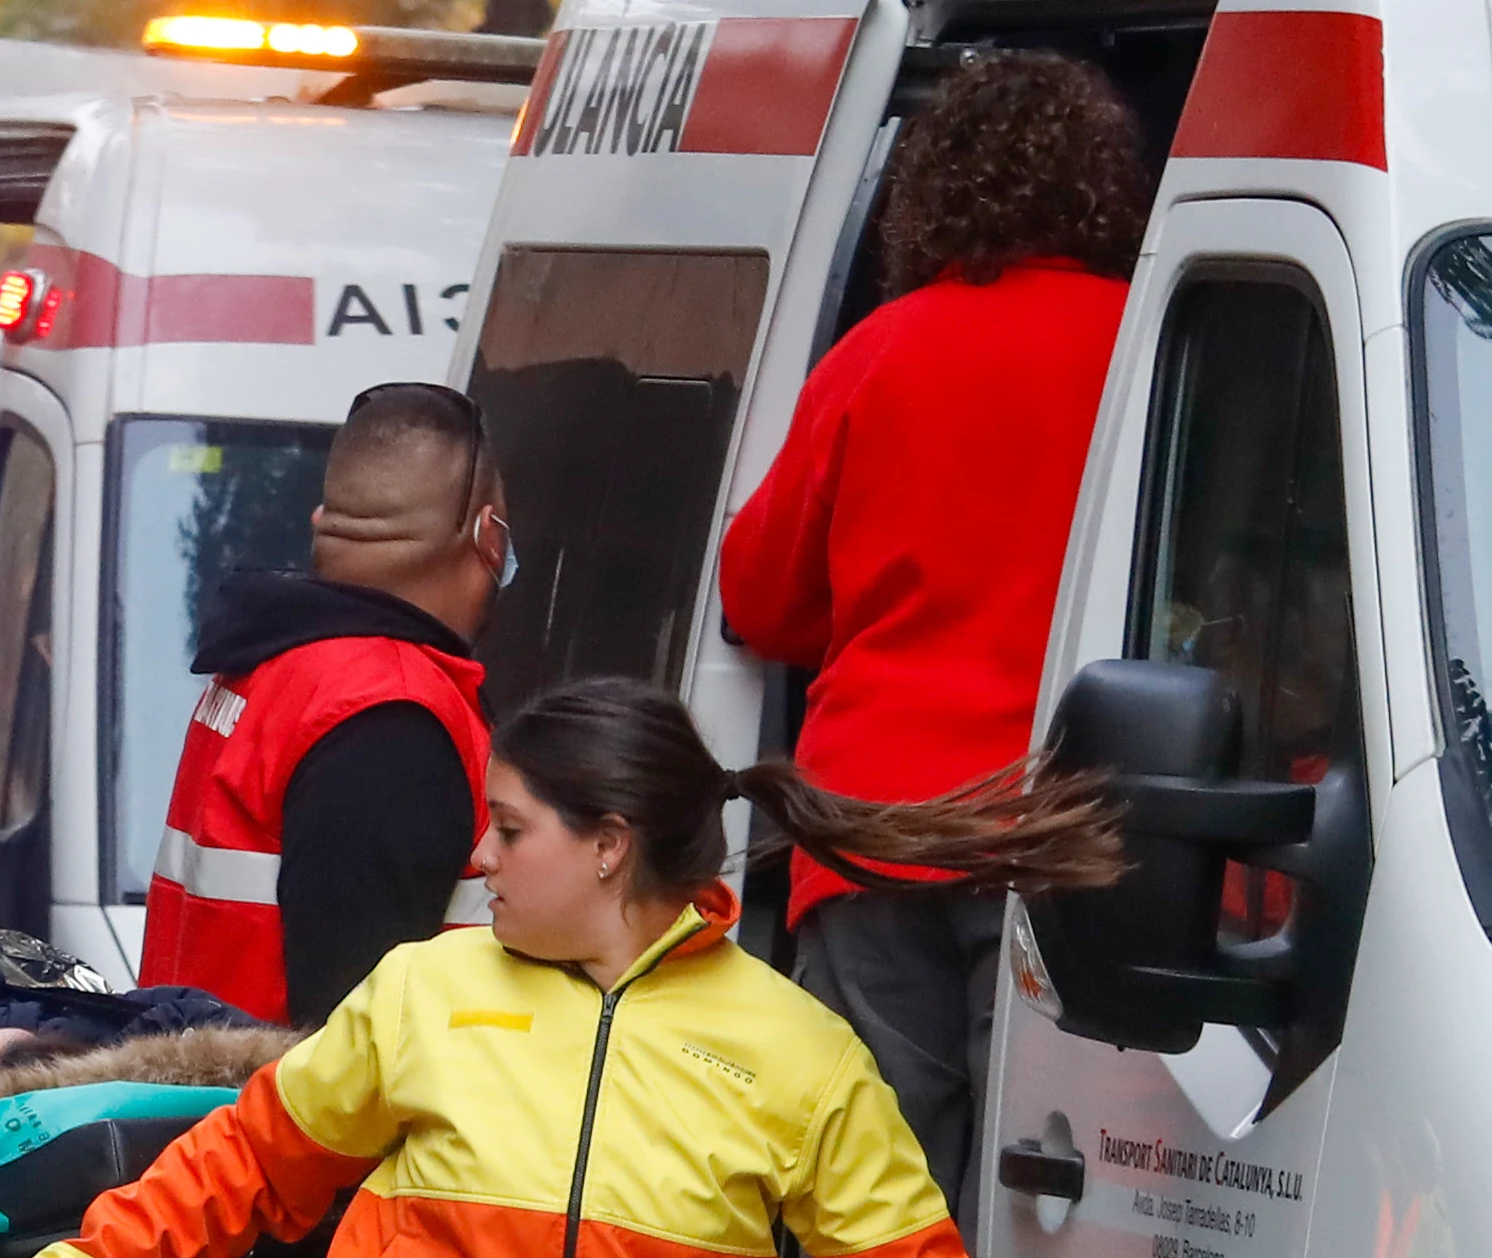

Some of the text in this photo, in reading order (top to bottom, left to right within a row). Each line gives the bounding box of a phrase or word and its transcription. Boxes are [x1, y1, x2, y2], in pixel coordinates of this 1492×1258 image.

[1099, 1128, 1303, 1201] TRANSPORT SANITARI DE CATALUNYA, S.L.U.
